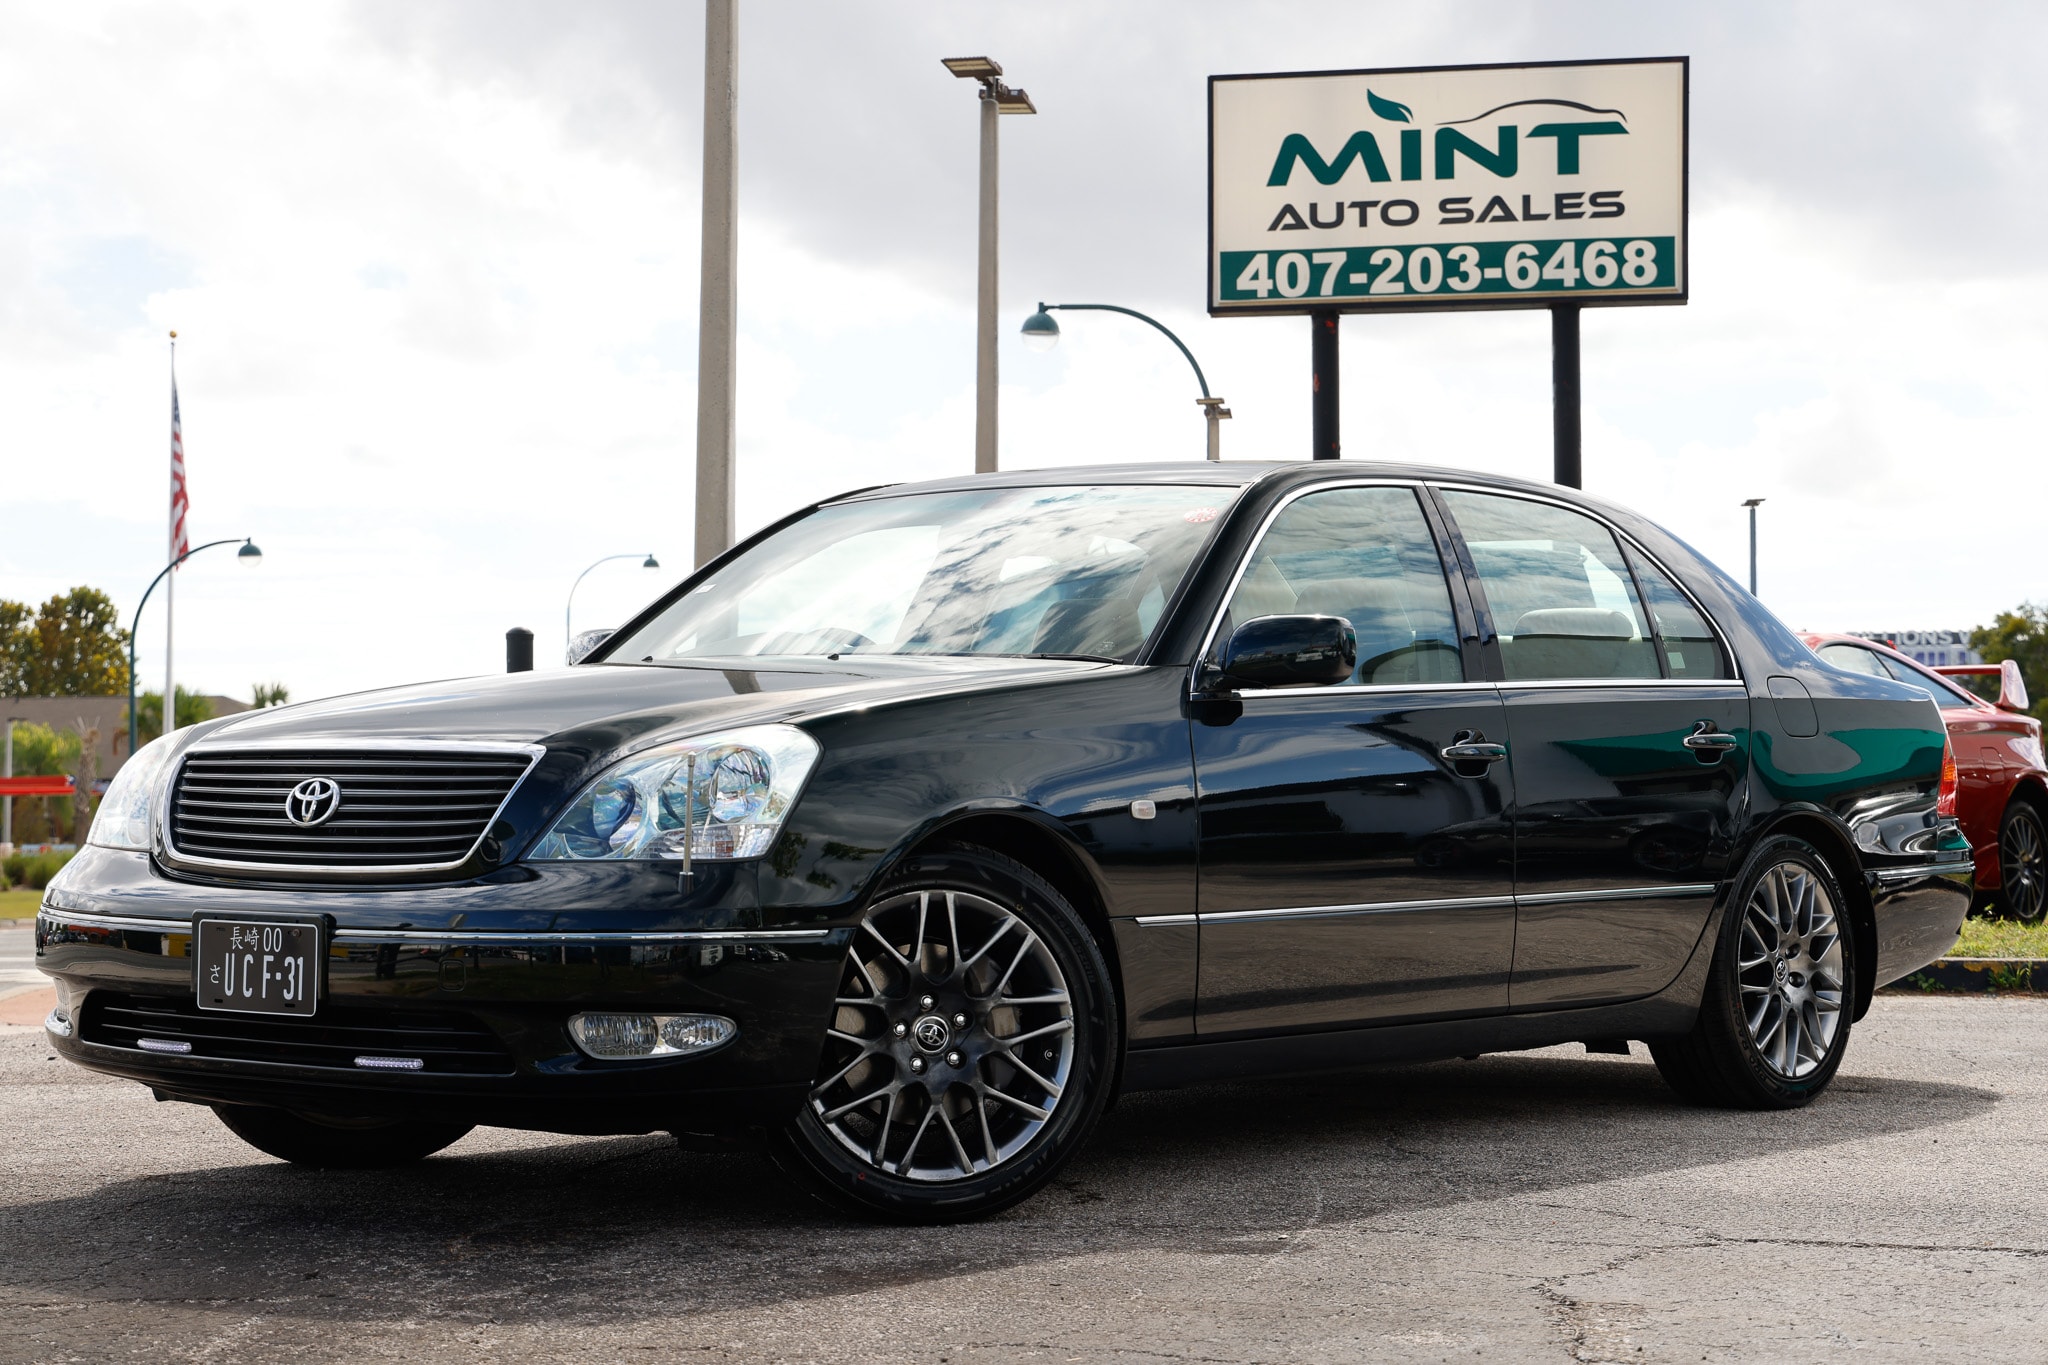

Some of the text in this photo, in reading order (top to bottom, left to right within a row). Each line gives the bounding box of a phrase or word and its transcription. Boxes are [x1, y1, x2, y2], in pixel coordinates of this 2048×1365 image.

[1266, 120, 1630, 187] MINT
[1266, 190, 1626, 232] AUTO SALES
[1235, 239, 1659, 299] 407-203-6468
